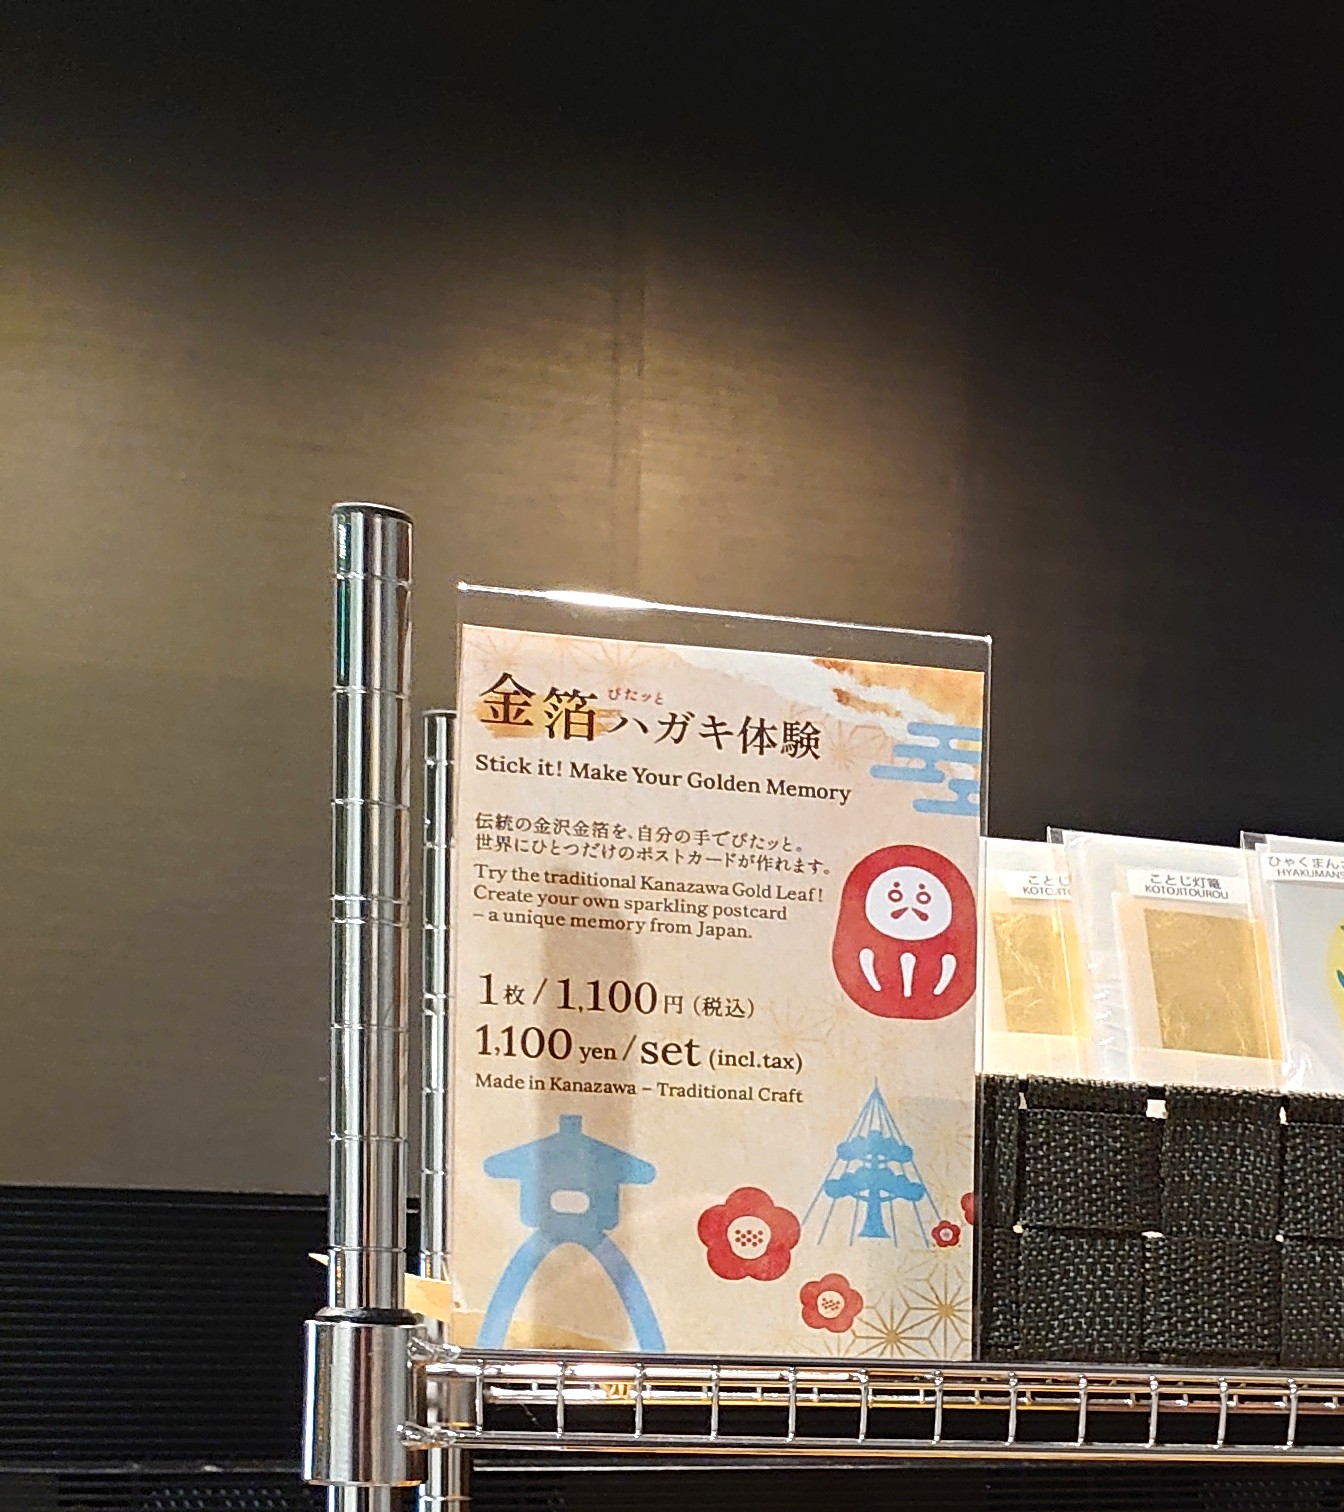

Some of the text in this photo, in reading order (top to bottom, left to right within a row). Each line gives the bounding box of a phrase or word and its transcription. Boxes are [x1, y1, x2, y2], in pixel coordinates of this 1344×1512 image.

[478, 672, 822, 760] 金箔ハガキ体験
[475, 755, 851, 805] Stick it! Make Your Golden Memory
[474, 864, 823, 903] Try the traditional Kanazawa Gold Leaf!
[1145, 885, 1229, 899] KOTOJITOUROU
[474, 885, 787, 921] Create your own sparkling postcard
[489, 913, 753, 942] a unique memory from Japan.
[475, 1024, 803, 1073] 1,100 yen set (incl.tax)
[476, 1073, 803, 1103] Made in Kanazawa Traditional Craft
